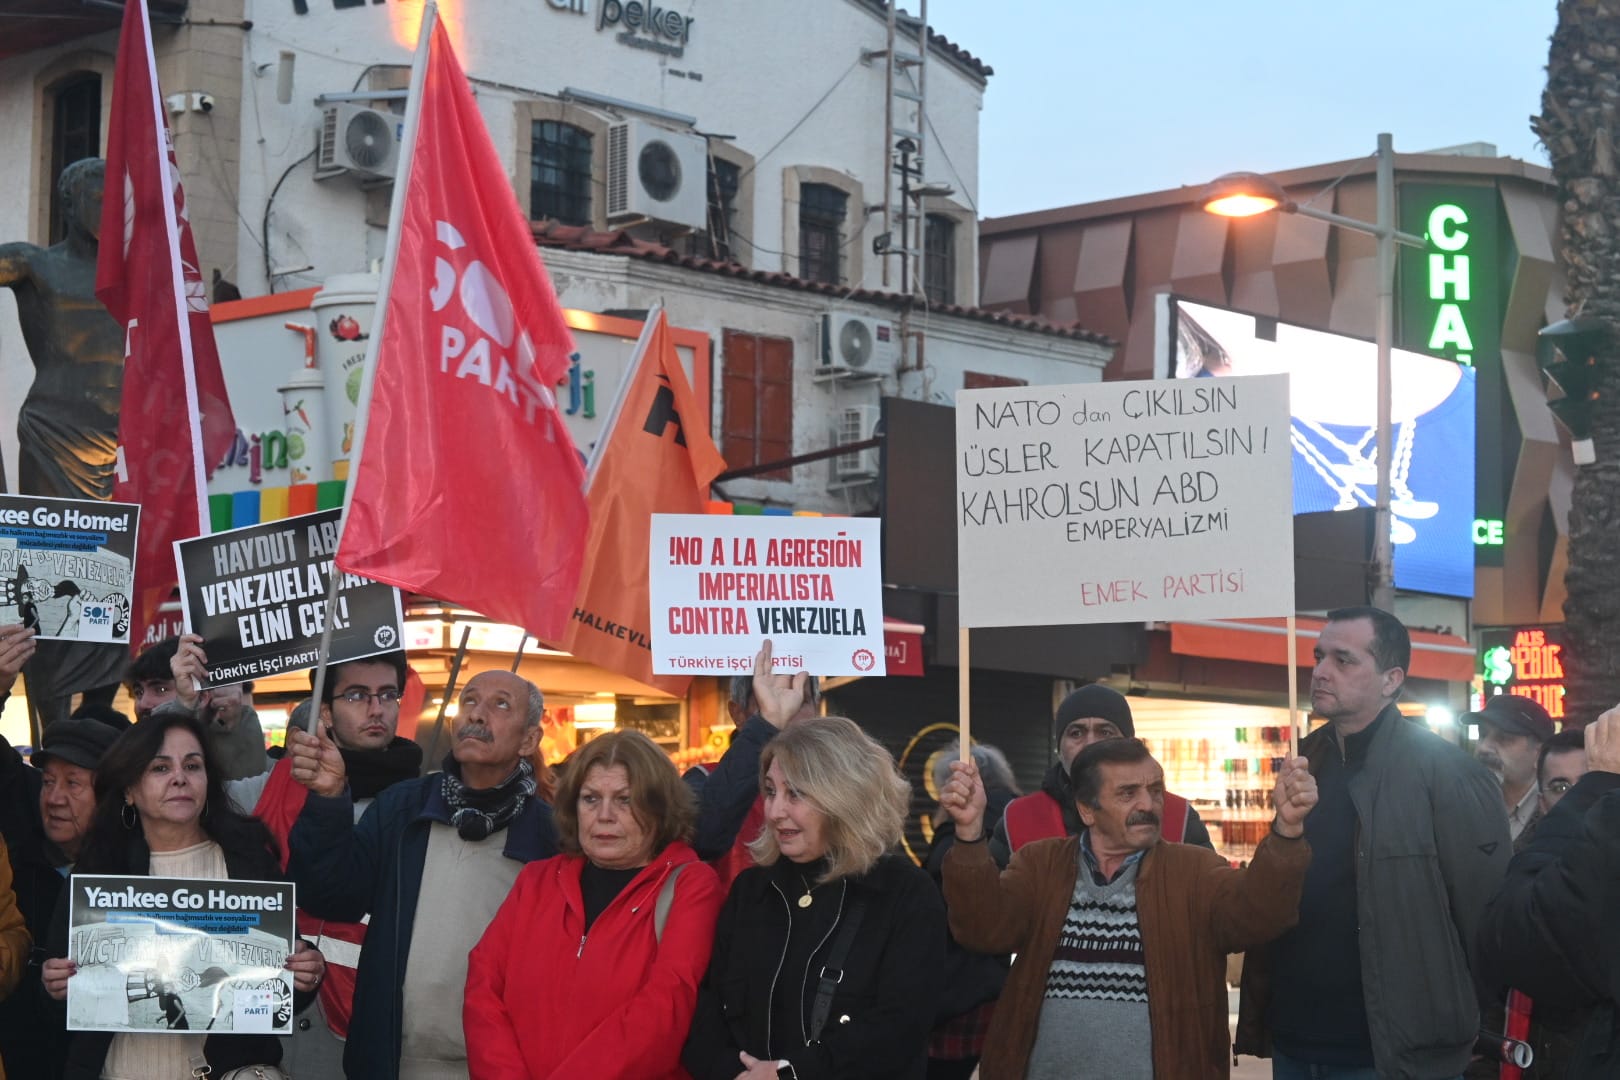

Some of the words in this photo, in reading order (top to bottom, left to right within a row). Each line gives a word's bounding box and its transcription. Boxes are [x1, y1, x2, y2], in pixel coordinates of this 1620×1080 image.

[1426, 203, 1474, 366] CHA
[1123, 385, 1237, 419] ÇIKILSIN
[964, 443, 1059, 477] ÜSLER
[962, 476, 1140, 526] KAHROLSUN
[1152, 471, 1219, 506] ABD
[32, 507, 61, 527] Go
[64, 509, 128, 532] Home!
[213, 529, 297, 577] HAYDUT
[710, 537, 725, 566] A
[733, 537, 757, 566] LA
[698, 572, 835, 601] IMPERIALISTA
[1081, 580, 1149, 606] EMEK
[84, 606, 110, 618] SOL
[668, 606, 750, 635] CONTRA
[757, 607, 867, 636] VENEZUELA
[238, 606, 294, 649] ELİNİ
[208, 663, 258, 682] TÜRKİYE
[259, 655, 284, 673] İŞÇİ
[285, 648, 330, 667] PARTİ
[669, 656, 724, 668] TÜRKİYE
[727, 656, 752, 670] İŞÇİ
[771, 655, 803, 668] RTİSİ
[84, 886, 168, 909] Yankee
[172, 888, 204, 909] Go
[208, 889, 283, 911] Home!
